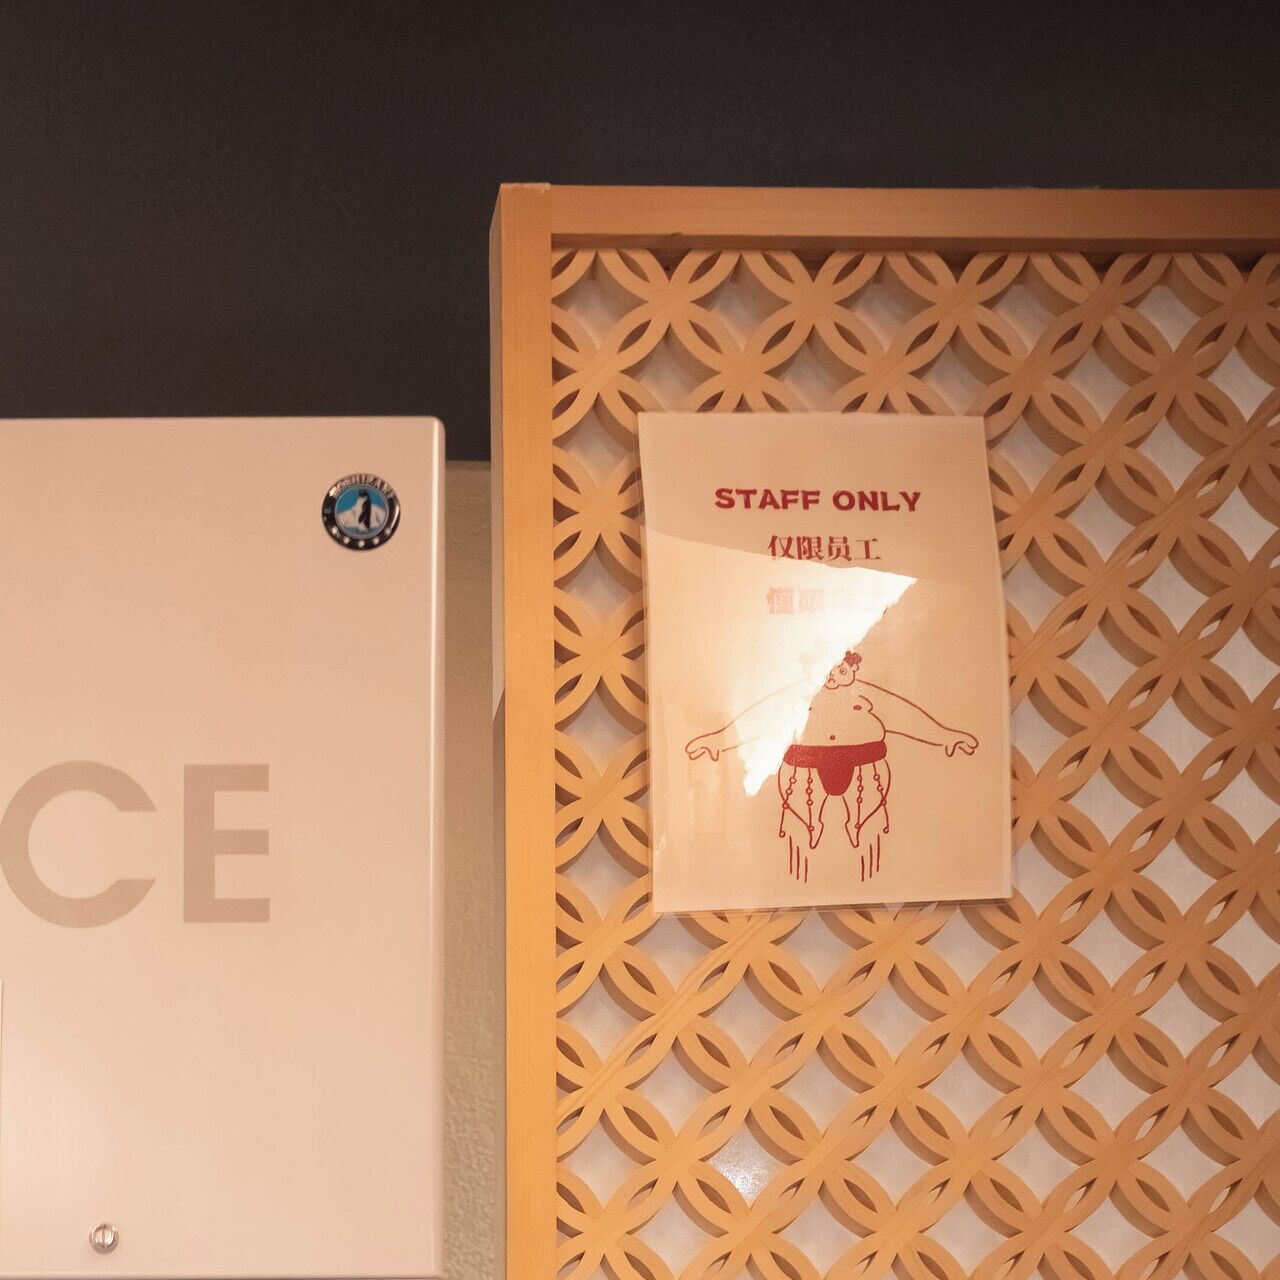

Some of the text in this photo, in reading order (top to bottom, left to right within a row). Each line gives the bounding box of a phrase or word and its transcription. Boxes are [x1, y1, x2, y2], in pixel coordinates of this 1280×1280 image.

[715, 488, 921, 512] STAFF ONLY
[768, 535, 882, 562] 仅限员工
